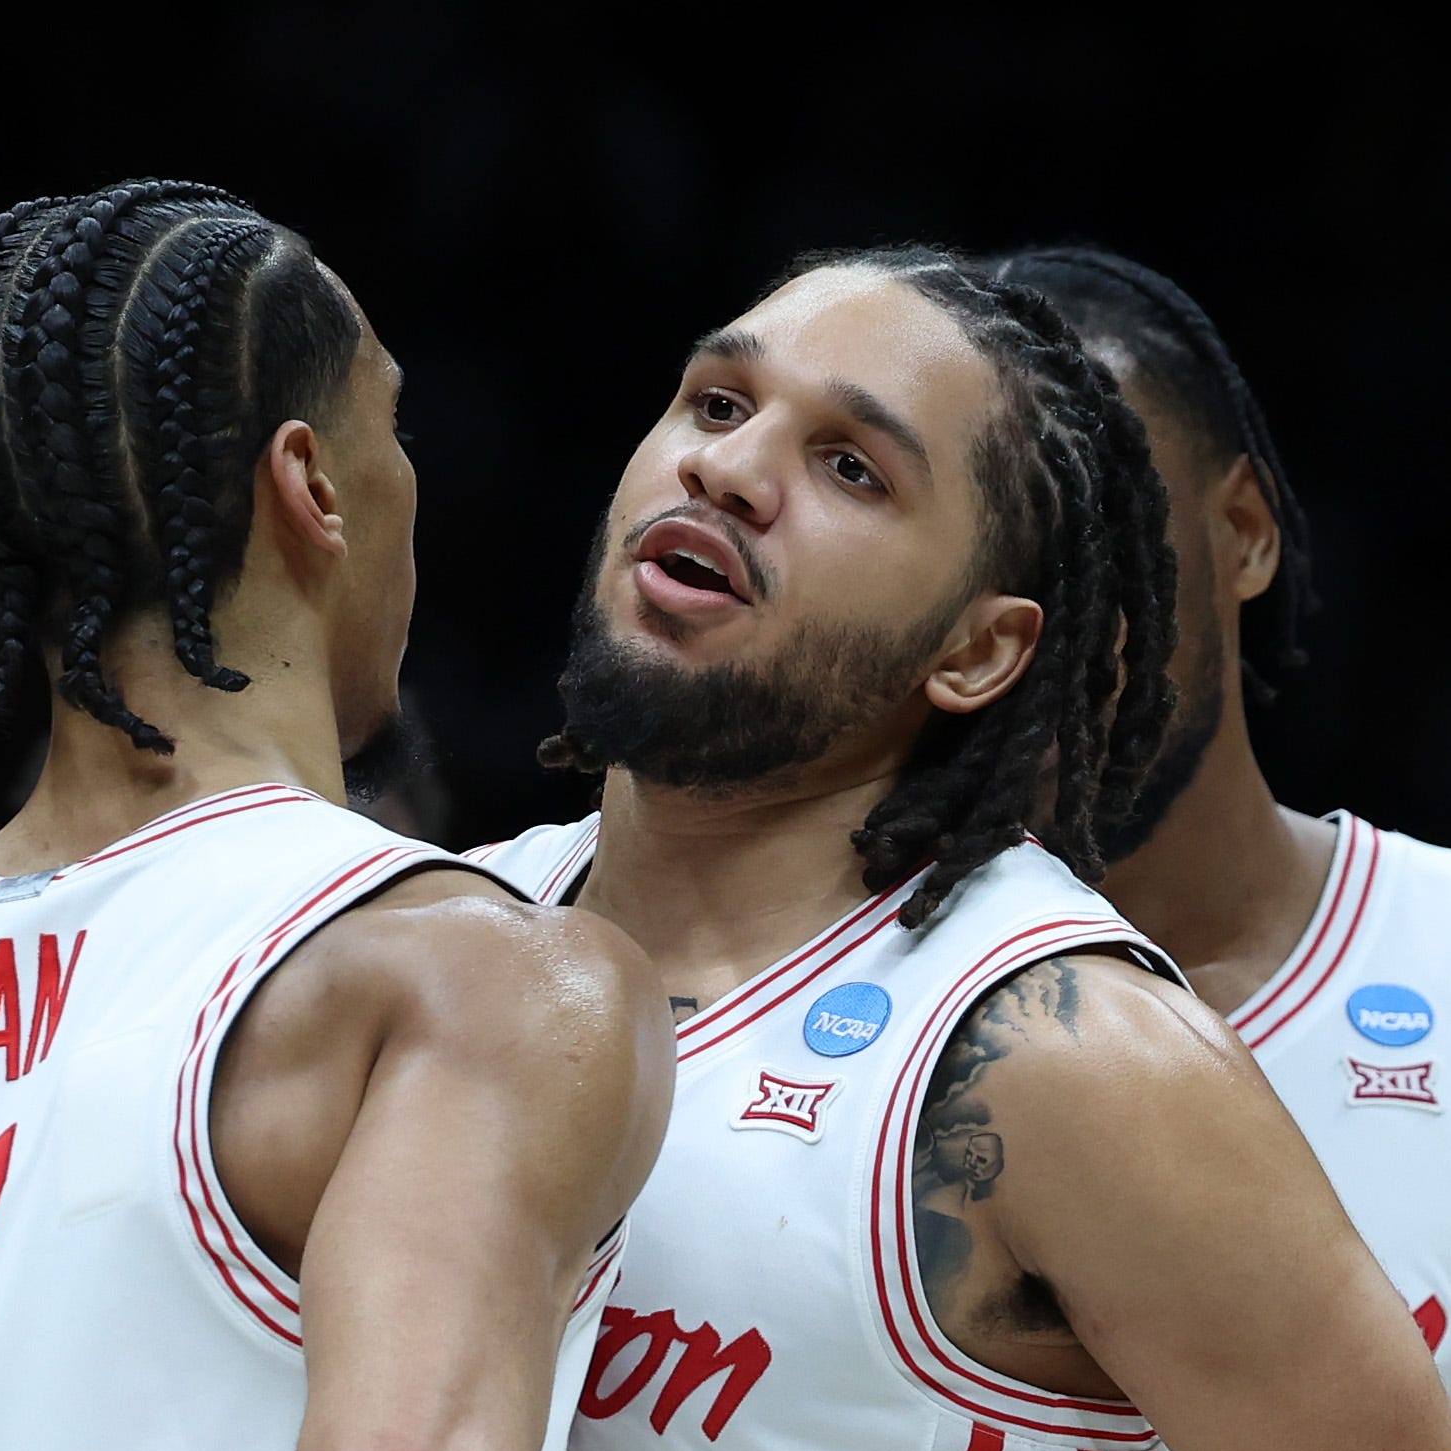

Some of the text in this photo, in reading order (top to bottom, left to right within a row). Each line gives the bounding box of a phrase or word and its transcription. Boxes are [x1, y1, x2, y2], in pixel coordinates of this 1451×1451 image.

[812, 1011, 879, 1042] NCAA
[1358, 1008, 1430, 1031] NCAA
[578, 1306, 772, 1442] on
